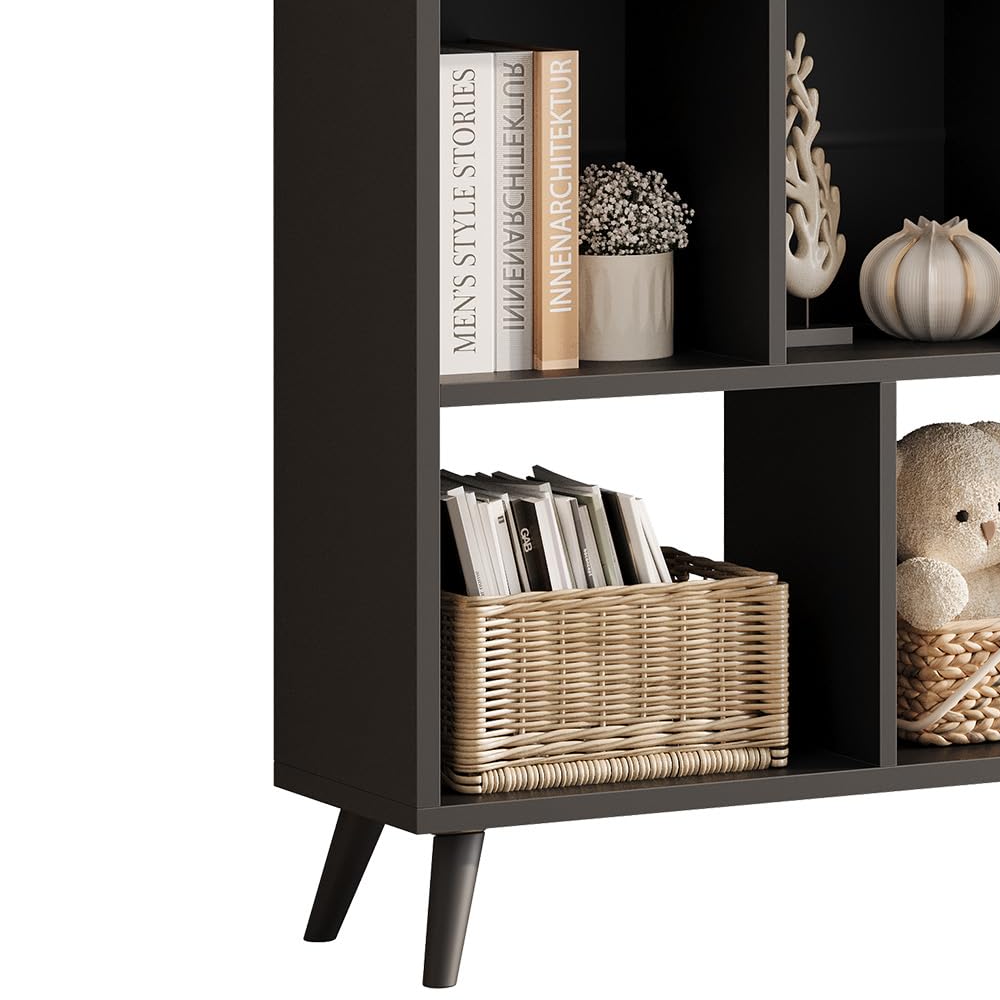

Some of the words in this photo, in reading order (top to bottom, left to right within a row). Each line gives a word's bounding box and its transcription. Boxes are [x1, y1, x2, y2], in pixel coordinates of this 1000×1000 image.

[452, 68, 477, 178] STORIES
[452, 185, 477, 267] STYLE
[550, 58, 572, 313] INNENARCHITEKTUR
[520, 527, 533, 553] GAB
